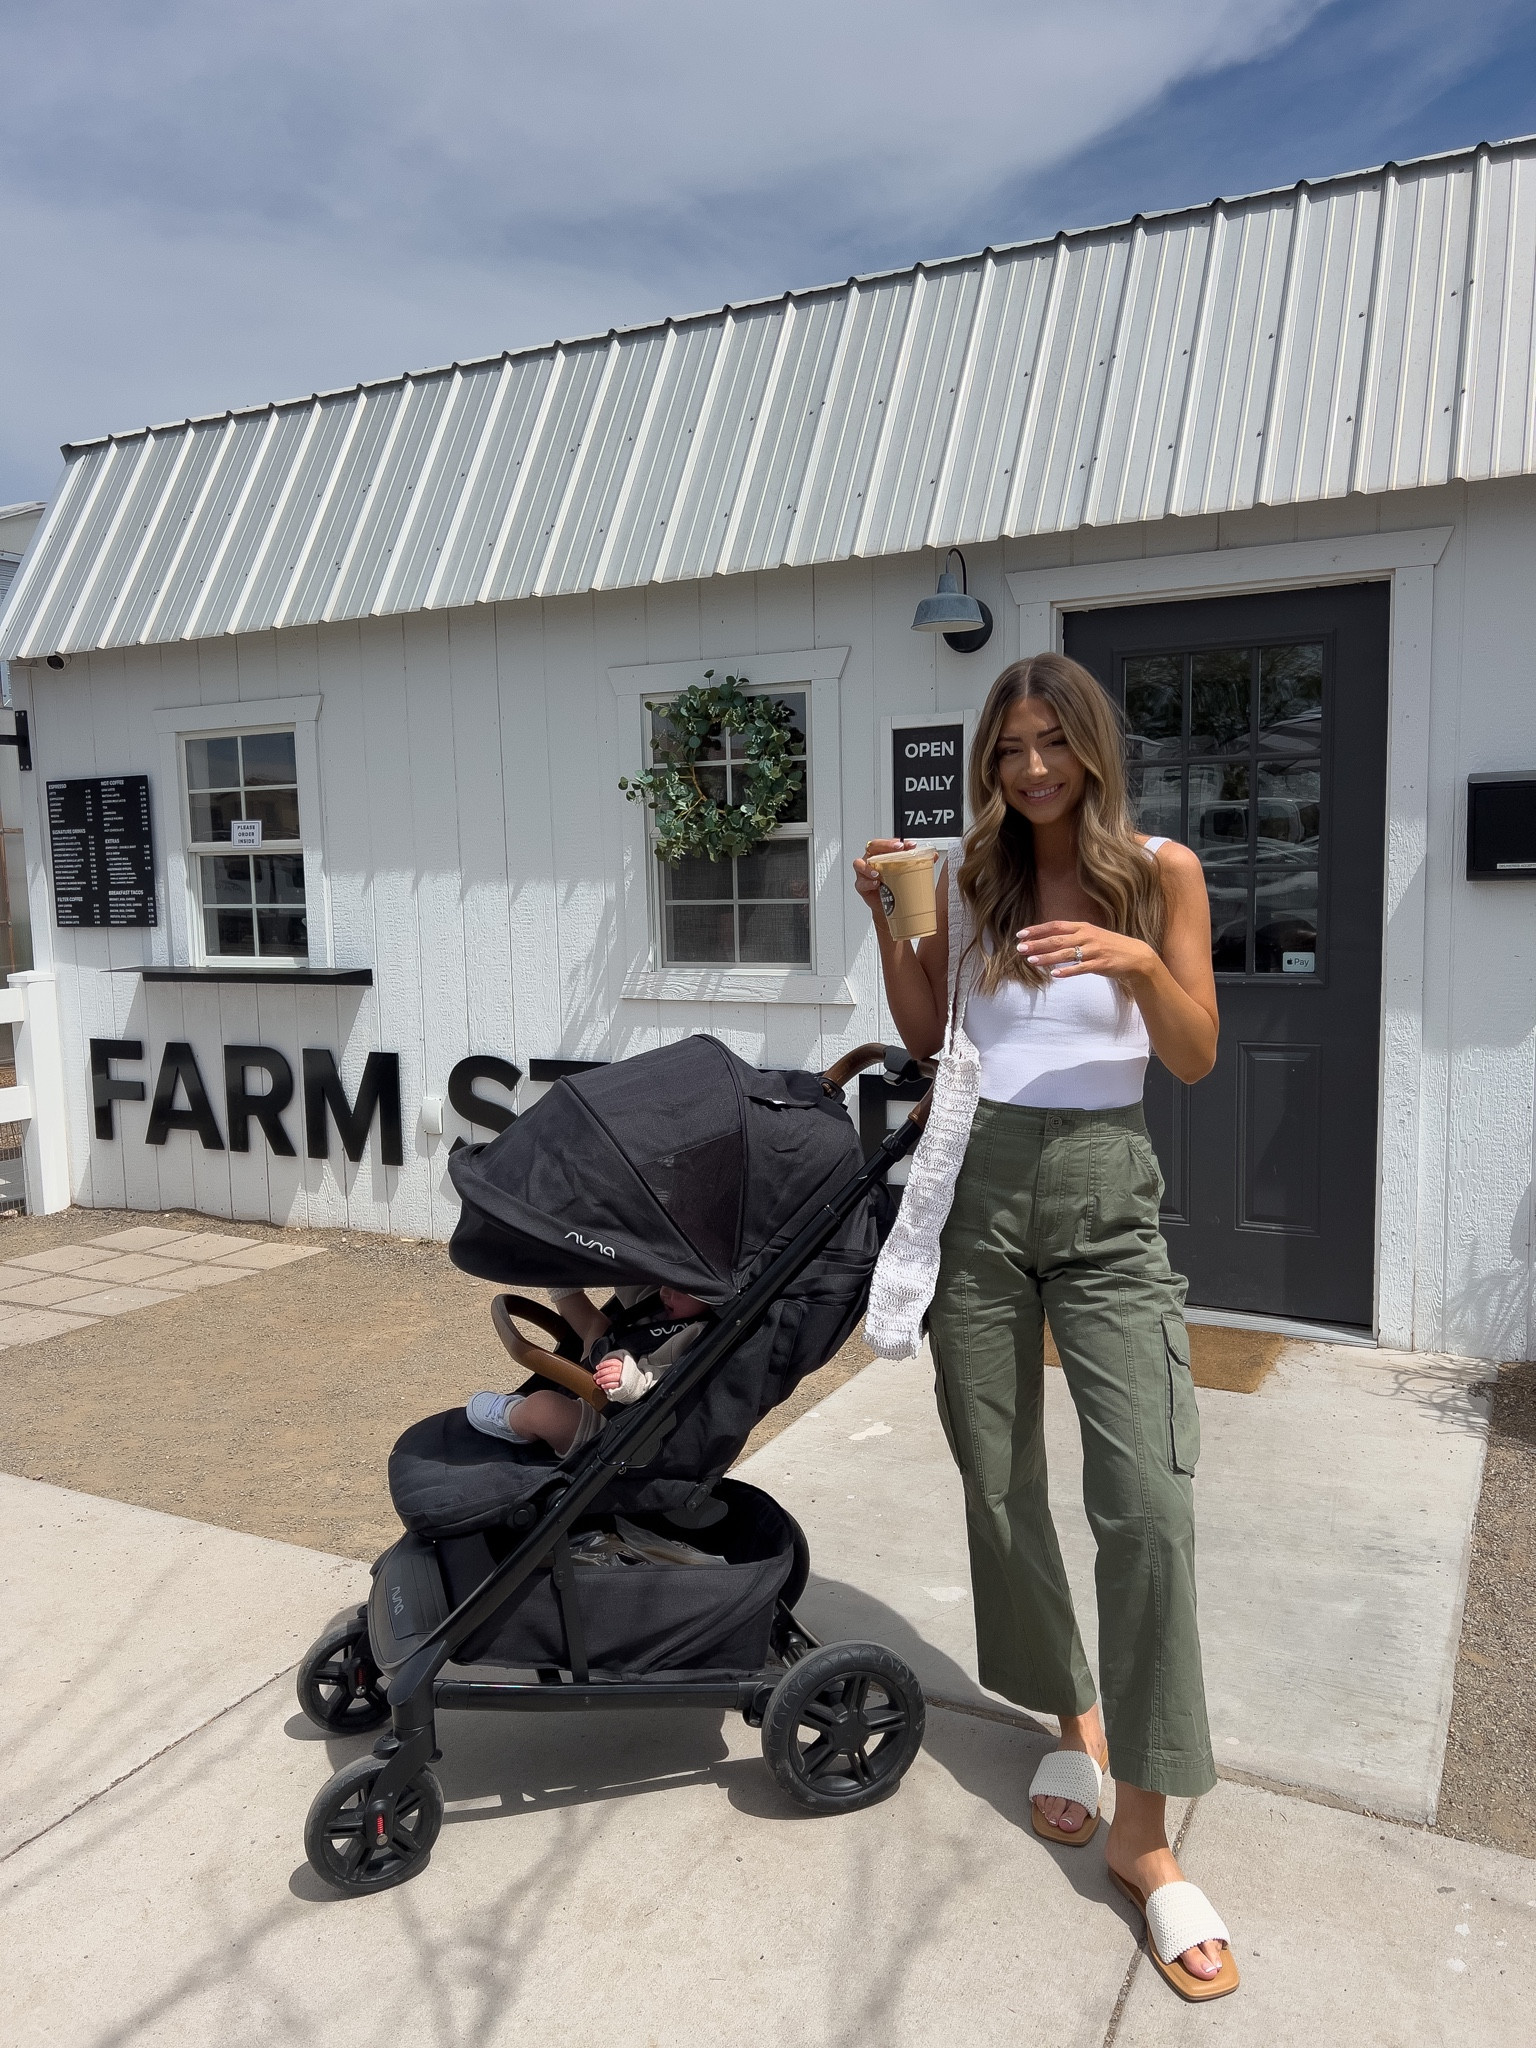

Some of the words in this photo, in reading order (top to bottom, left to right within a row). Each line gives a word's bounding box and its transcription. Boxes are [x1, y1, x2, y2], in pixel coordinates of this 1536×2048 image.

[905, 740, 954, 759] OPEN
[905, 775, 955, 792] DAILY
[904, 809, 955, 827] 7A-7P
[1294, 958, 1310, 967] Pay
[89, 1038, 404, 1167] FARM
[564, 1231, 616, 1260] nuna
[649, 1322, 690, 1337] una
